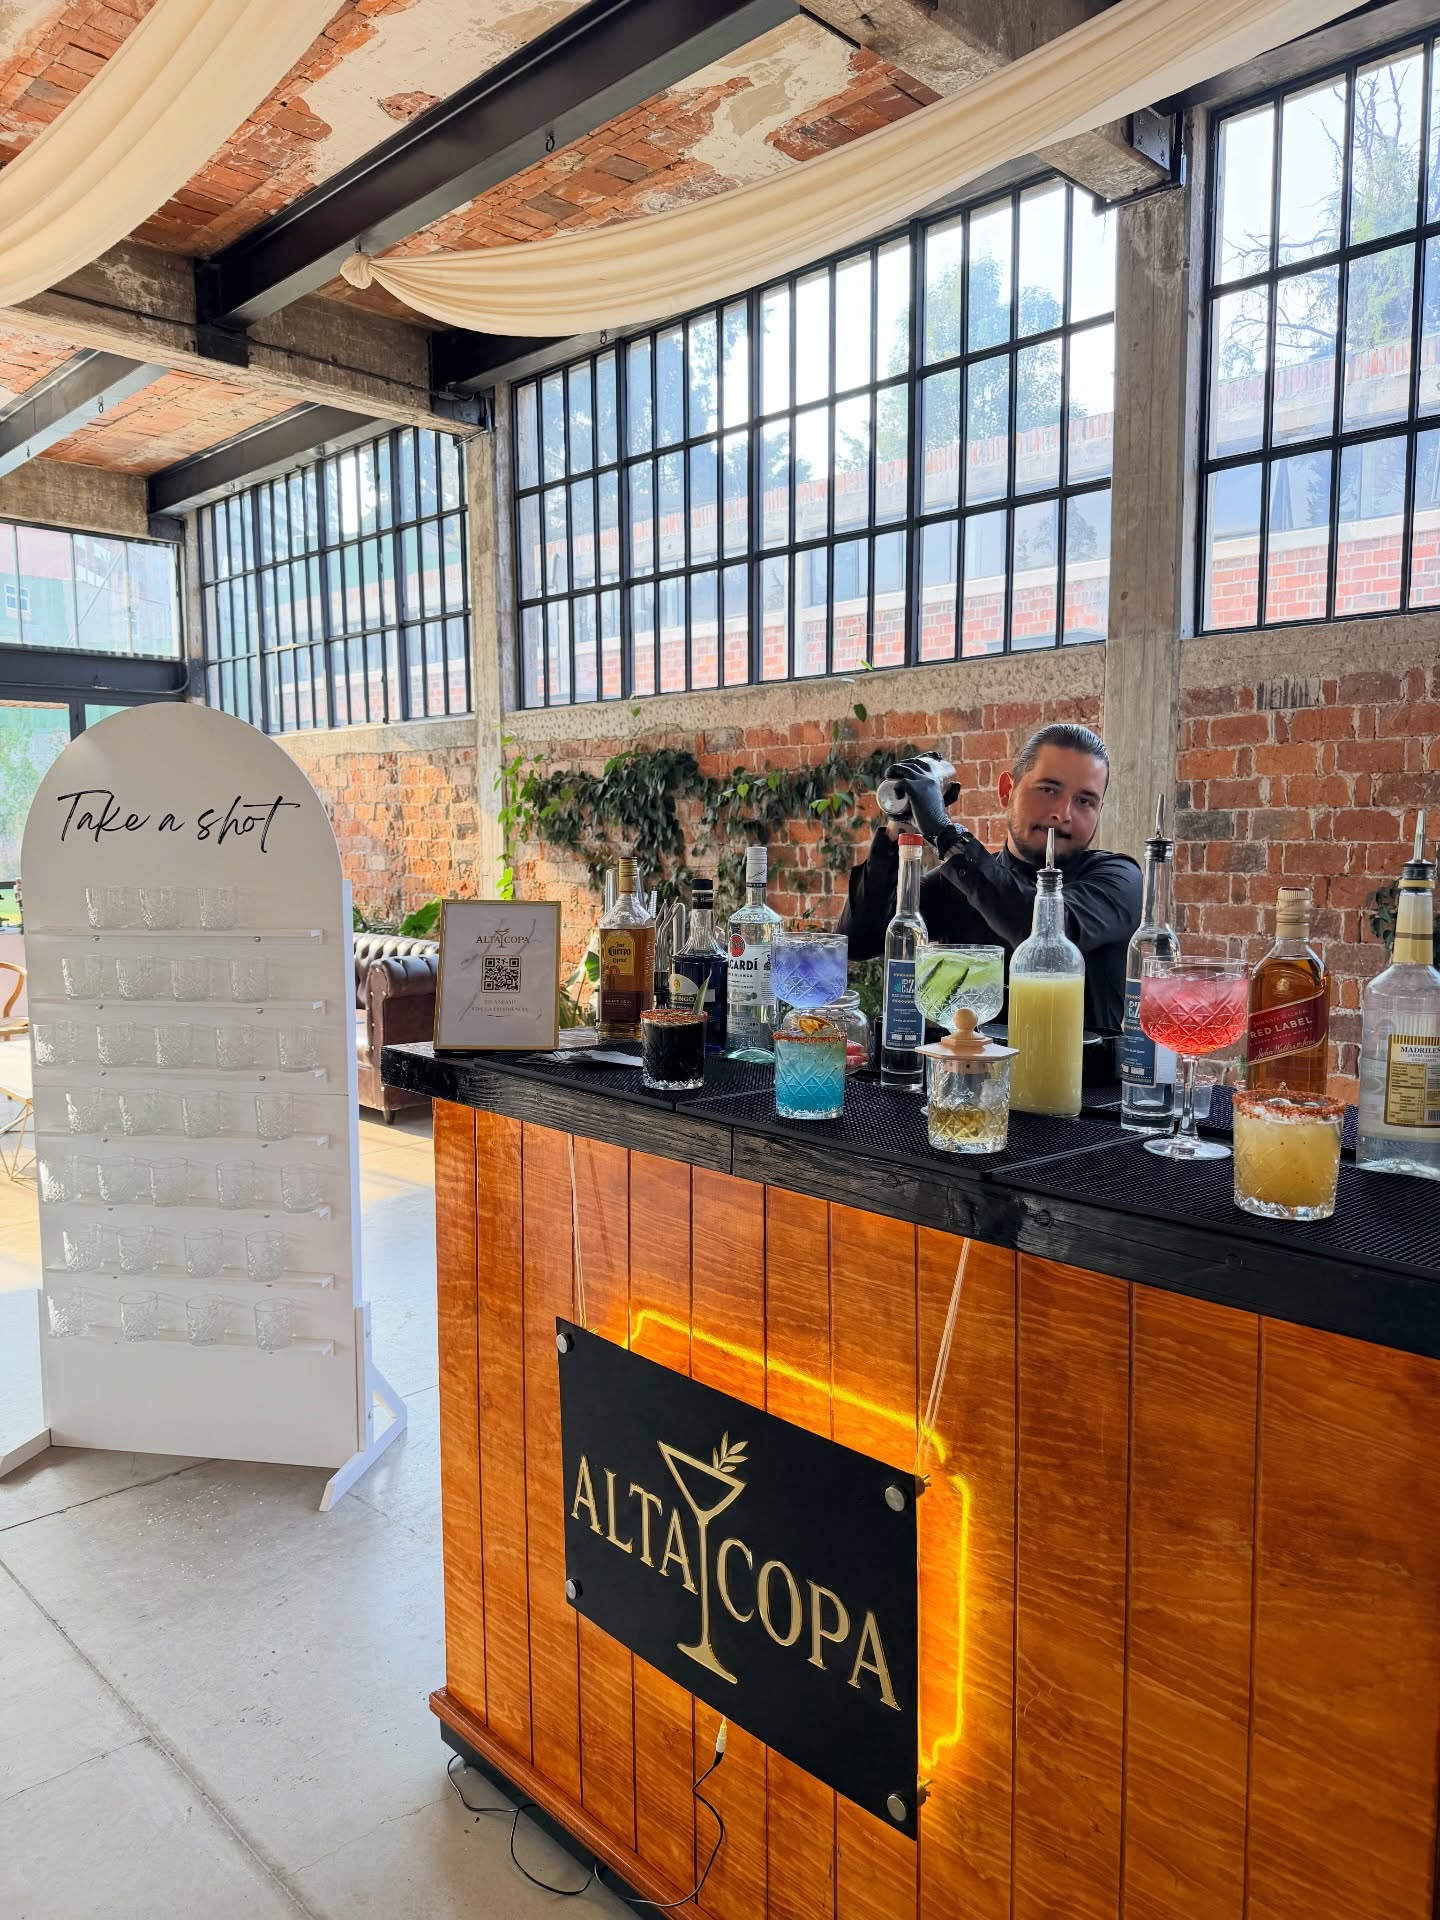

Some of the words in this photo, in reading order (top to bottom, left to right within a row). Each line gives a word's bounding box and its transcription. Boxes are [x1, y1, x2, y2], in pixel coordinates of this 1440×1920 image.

[57, 789, 150, 842] Take
[158, 813, 185, 832] a
[196, 795, 301, 853] shot
[475, 935, 500, 944] ALTA
[504, 935, 530, 944] COPA
[728, 957, 758, 971] CARDÍ
[1250, 1028, 1272, 1038] RED
[1274, 1016, 1313, 1032] LABEL
[570, 1454, 699, 1596] ALTA
[715, 1537, 902, 1712] COPA
